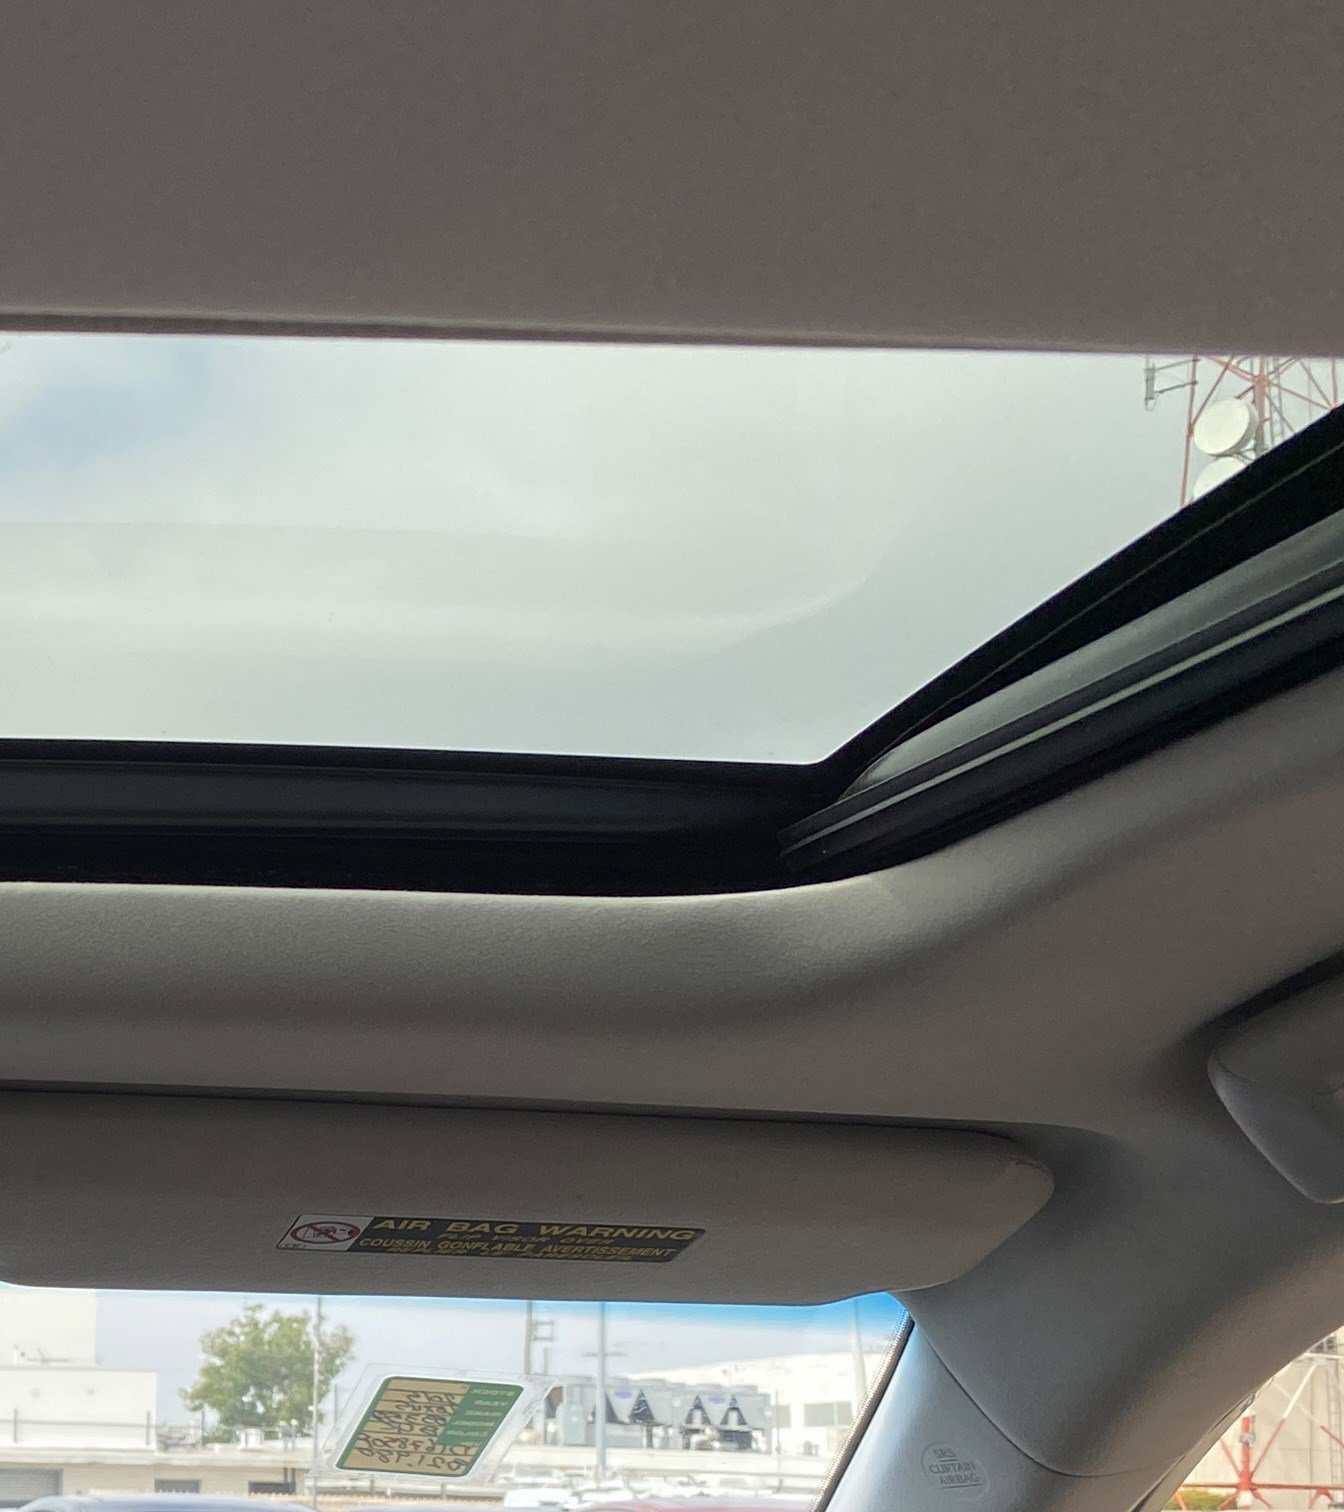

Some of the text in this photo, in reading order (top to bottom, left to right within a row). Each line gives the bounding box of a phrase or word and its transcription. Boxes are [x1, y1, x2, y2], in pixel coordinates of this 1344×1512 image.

[372, 1219, 433, 1231] AIR
[445, 1221, 519, 1235] BAG
[538, 1224, 694, 1241] WARNING
[359, 1238, 431, 1249] COUSSIN
[436, 1240, 539, 1254] GONFLABLE
[539, 1244, 678, 1258] AVERTISSEMENT
[932, 1447, 957, 1459] SRS
[929, 1461, 977, 1475] CURTAIN
[939, 1473, 981, 1485] AIRBAG
